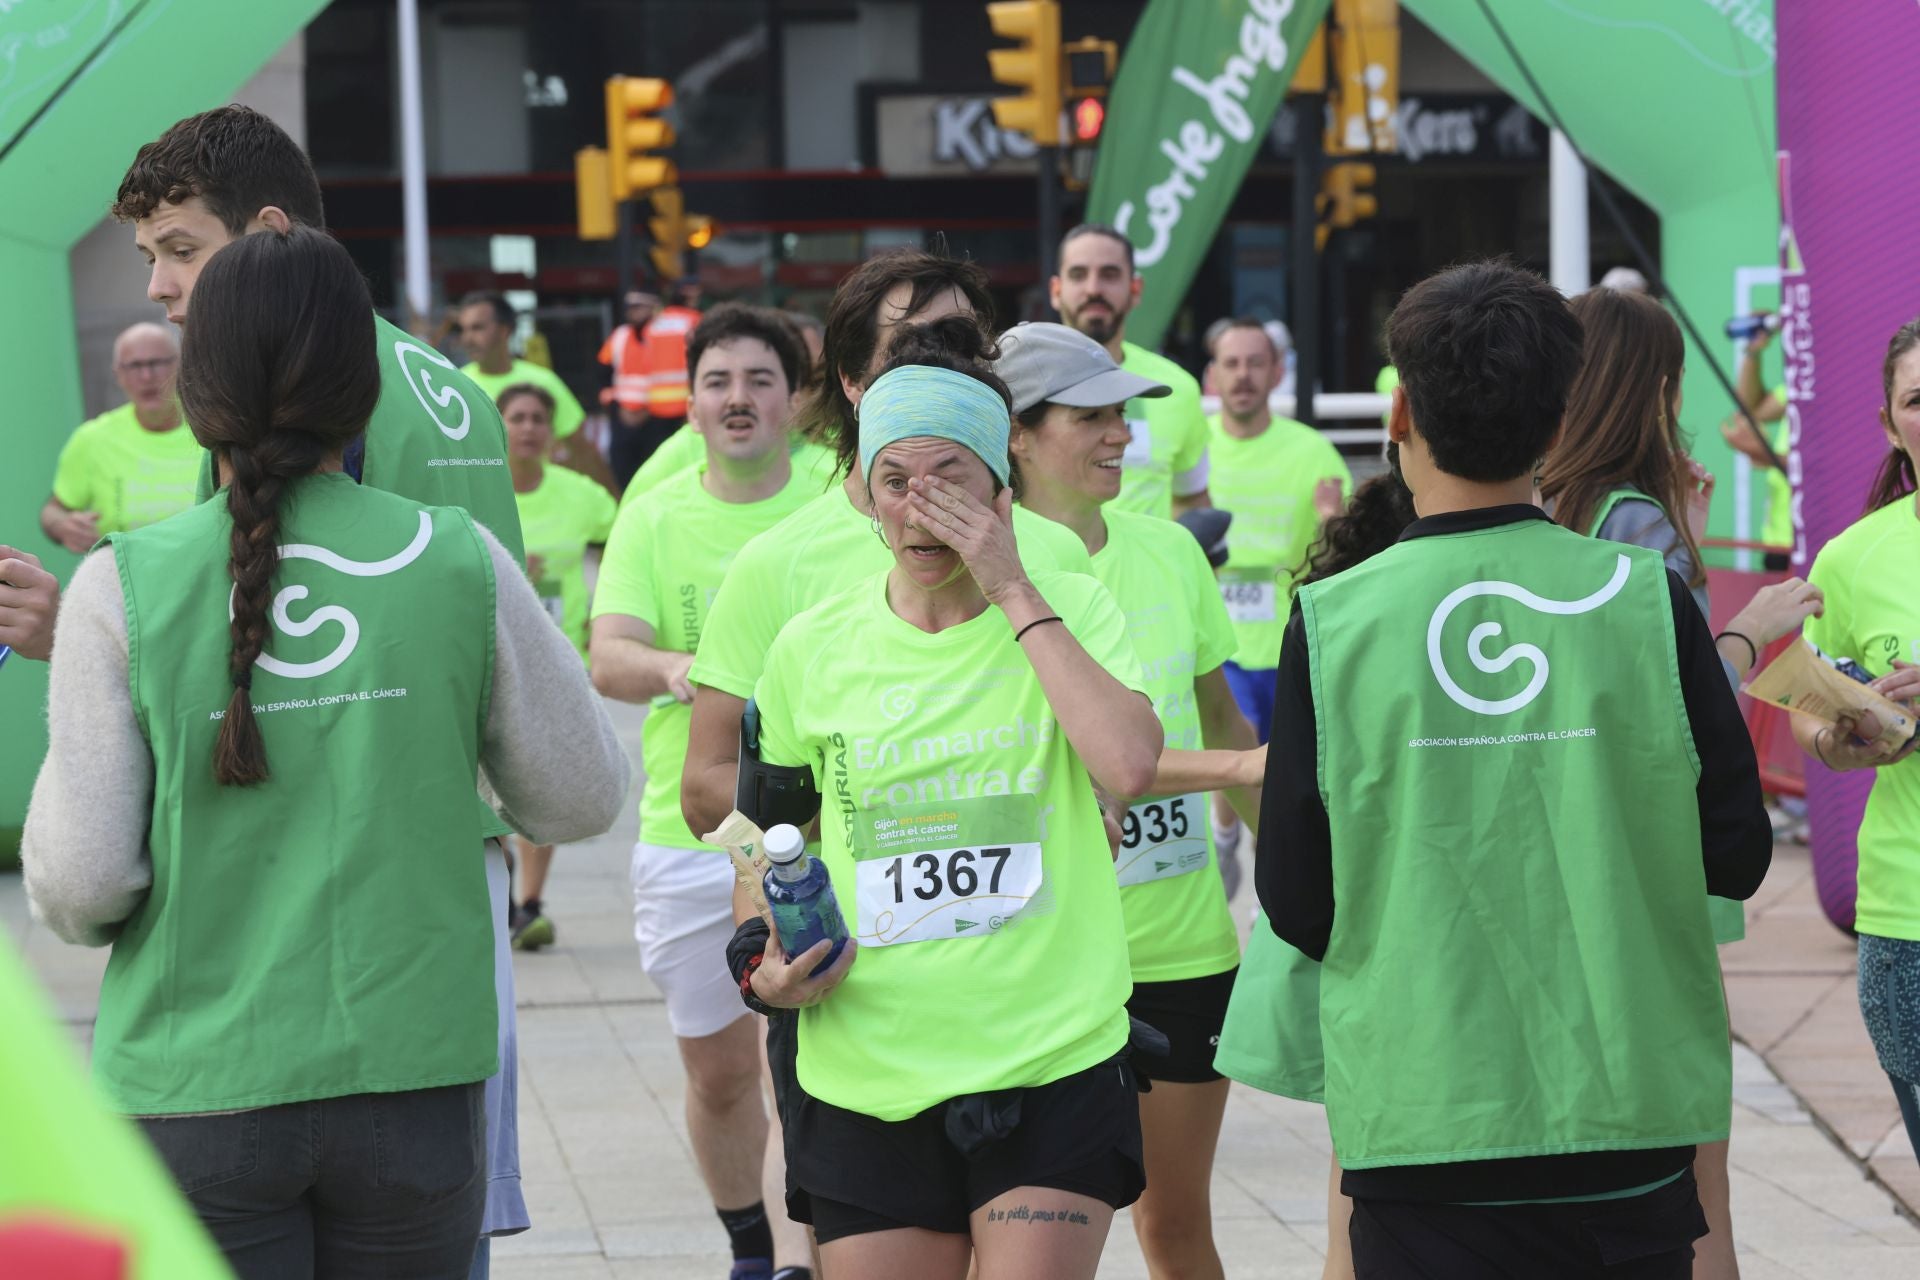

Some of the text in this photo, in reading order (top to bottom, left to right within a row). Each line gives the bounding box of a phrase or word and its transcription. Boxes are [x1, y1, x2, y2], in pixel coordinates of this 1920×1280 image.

[1114, 0, 1296, 267] Corte Ing
[268, 698, 317, 712] ESPAÑOLA
[318, 693, 358, 706] CONTRA
[359, 691, 371, 700] EL
[372, 687, 407, 699] CÁNCER
[1408, 727, 1596, 748] ASOCIACIÓN ESPAÑOLA CONTRA EL CÁNCER
[855, 737, 901, 769] En
[827, 732, 857, 858] STURIAS
[874, 811, 958, 831] Gijón en marcha
[875, 822, 959, 841] contra el cáncer
[885, 848, 1011, 903] 1367
